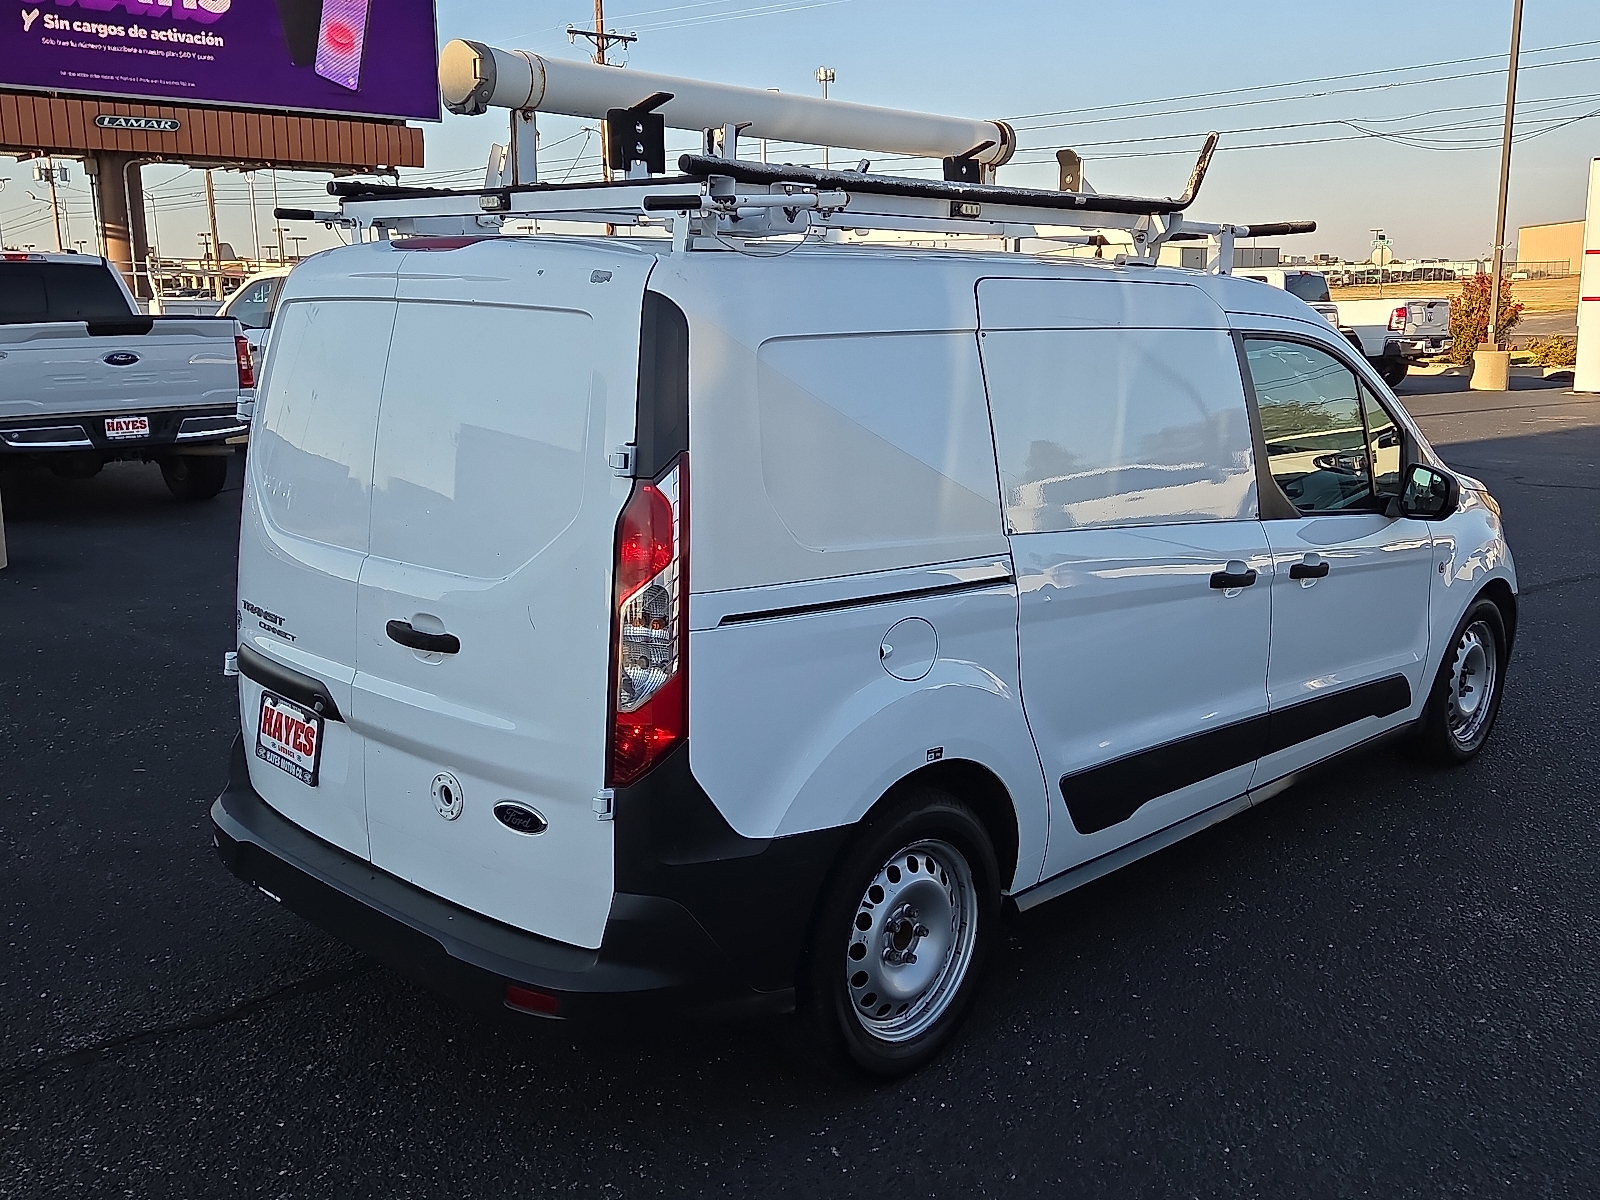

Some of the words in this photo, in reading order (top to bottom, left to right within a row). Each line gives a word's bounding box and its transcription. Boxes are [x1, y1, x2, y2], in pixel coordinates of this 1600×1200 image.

[21, 8, 39, 32] Y
[43, 13, 70, 31] Sin
[72, 20, 126, 38] cargos
[127, 24, 148, 39] de
[150, 27, 224, 47] activación
[103, 117, 172, 130] LAMAR
[106, 420, 147, 432] HAYES
[241, 599, 286, 627] TRANSIT
[258, 621, 297, 642] CONNECT
[261, 706, 315, 757] HAYES
[503, 807, 532, 829] Ford
